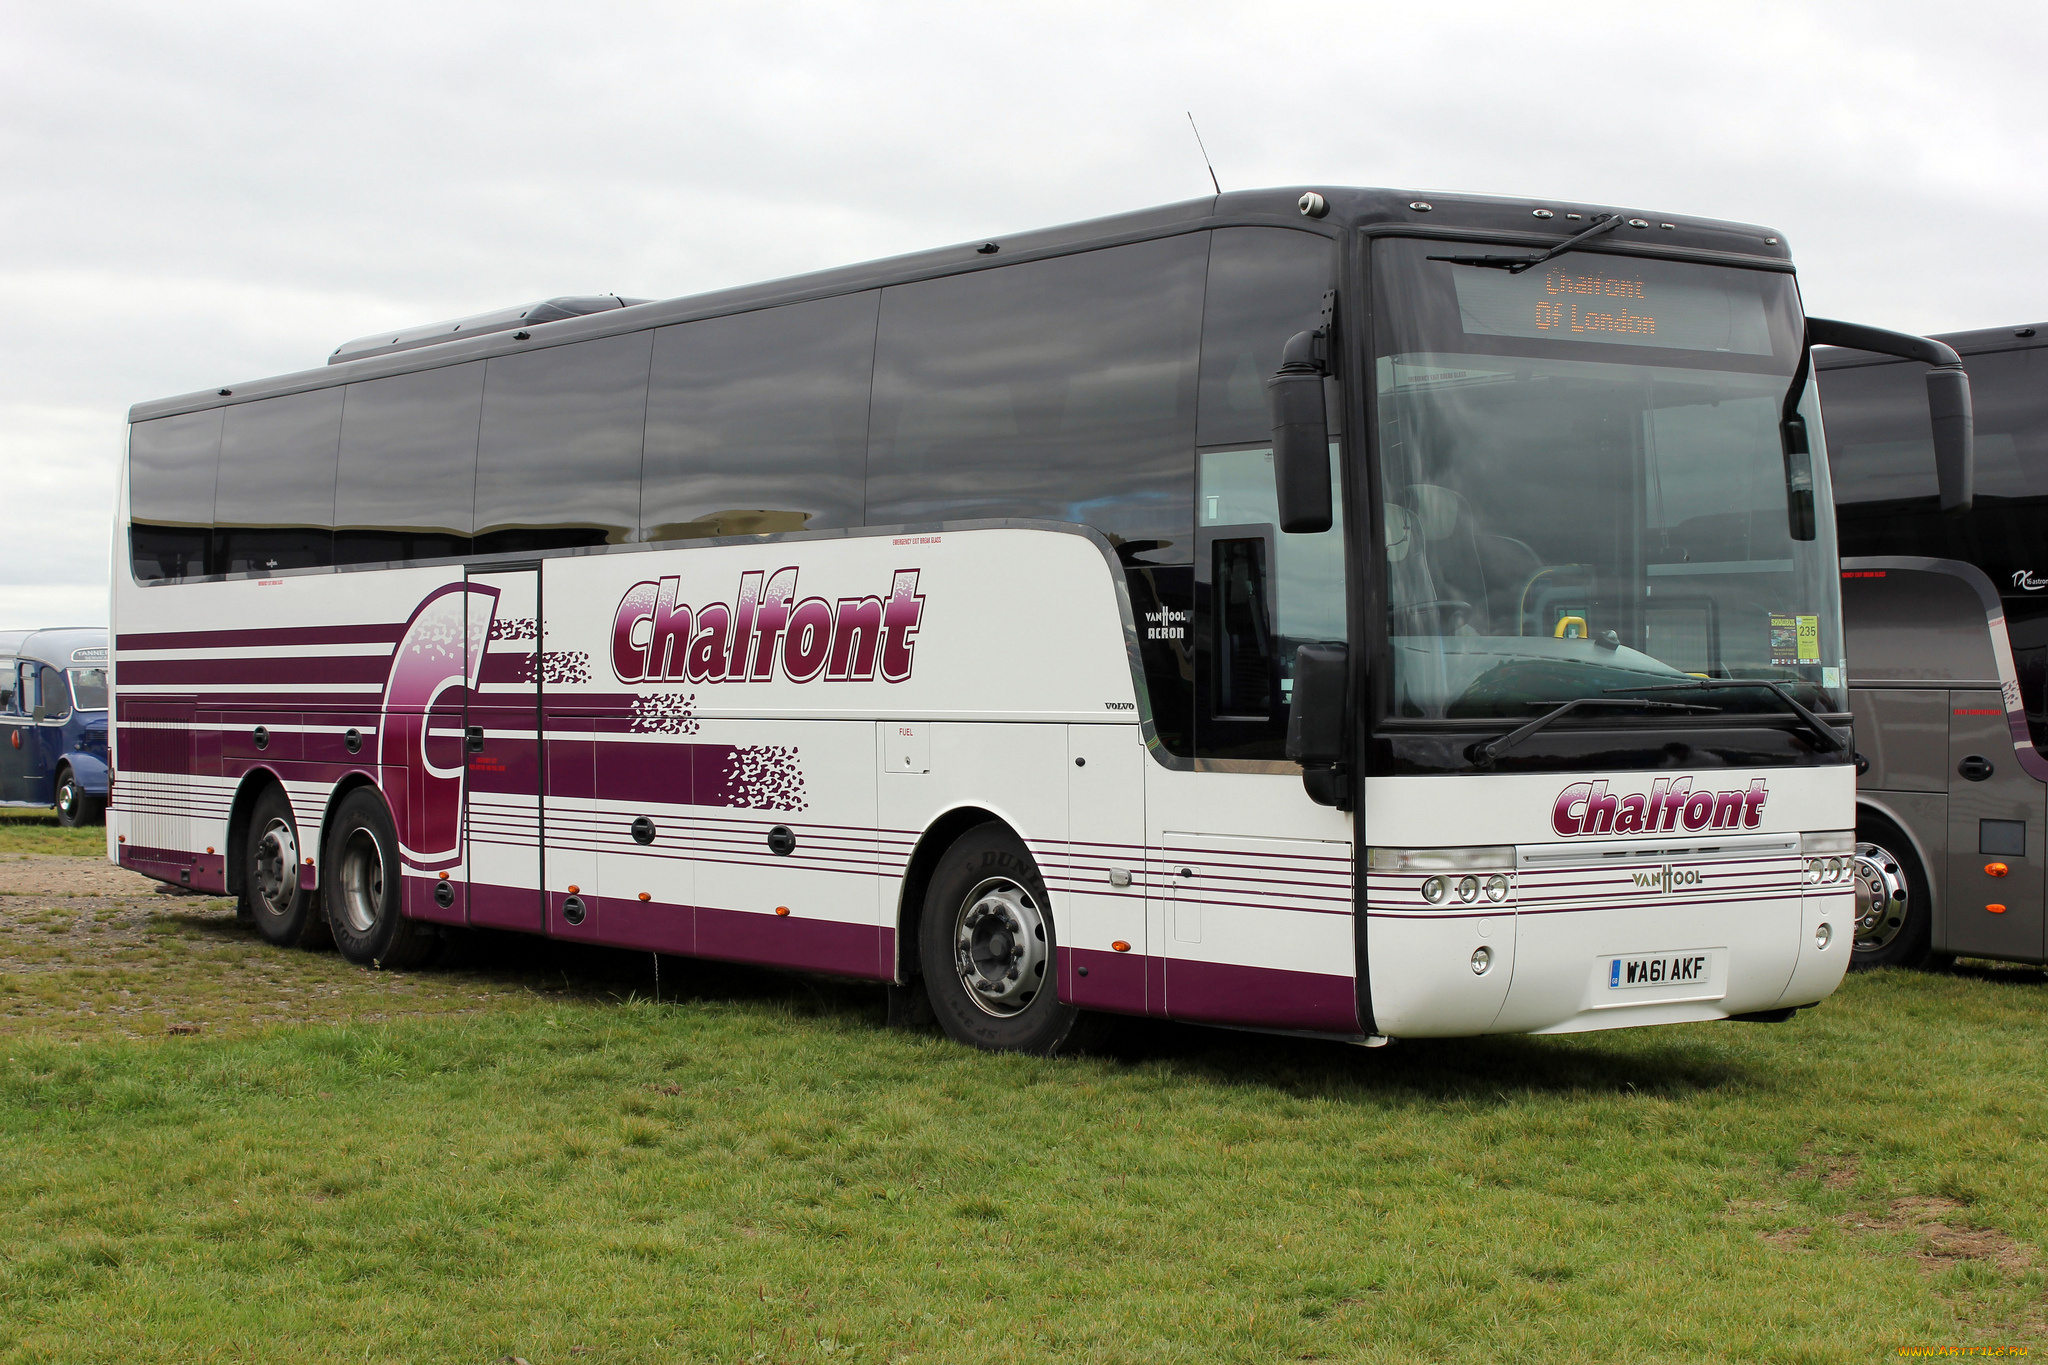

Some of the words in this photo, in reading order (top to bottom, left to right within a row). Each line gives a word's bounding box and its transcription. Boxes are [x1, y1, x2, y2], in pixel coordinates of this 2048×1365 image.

[1571, 304, 1656, 335] London
[610, 565, 926, 685] Chalfont
[1799, 625, 1816, 637] 235
[1105, 702, 1135, 710] VOLVO
[899, 727, 914, 736] FUEL
[1551, 776, 1770, 838] Chalfont
[1626, 959, 1667, 984] WA61
[1670, 956, 1706, 980] AKF
